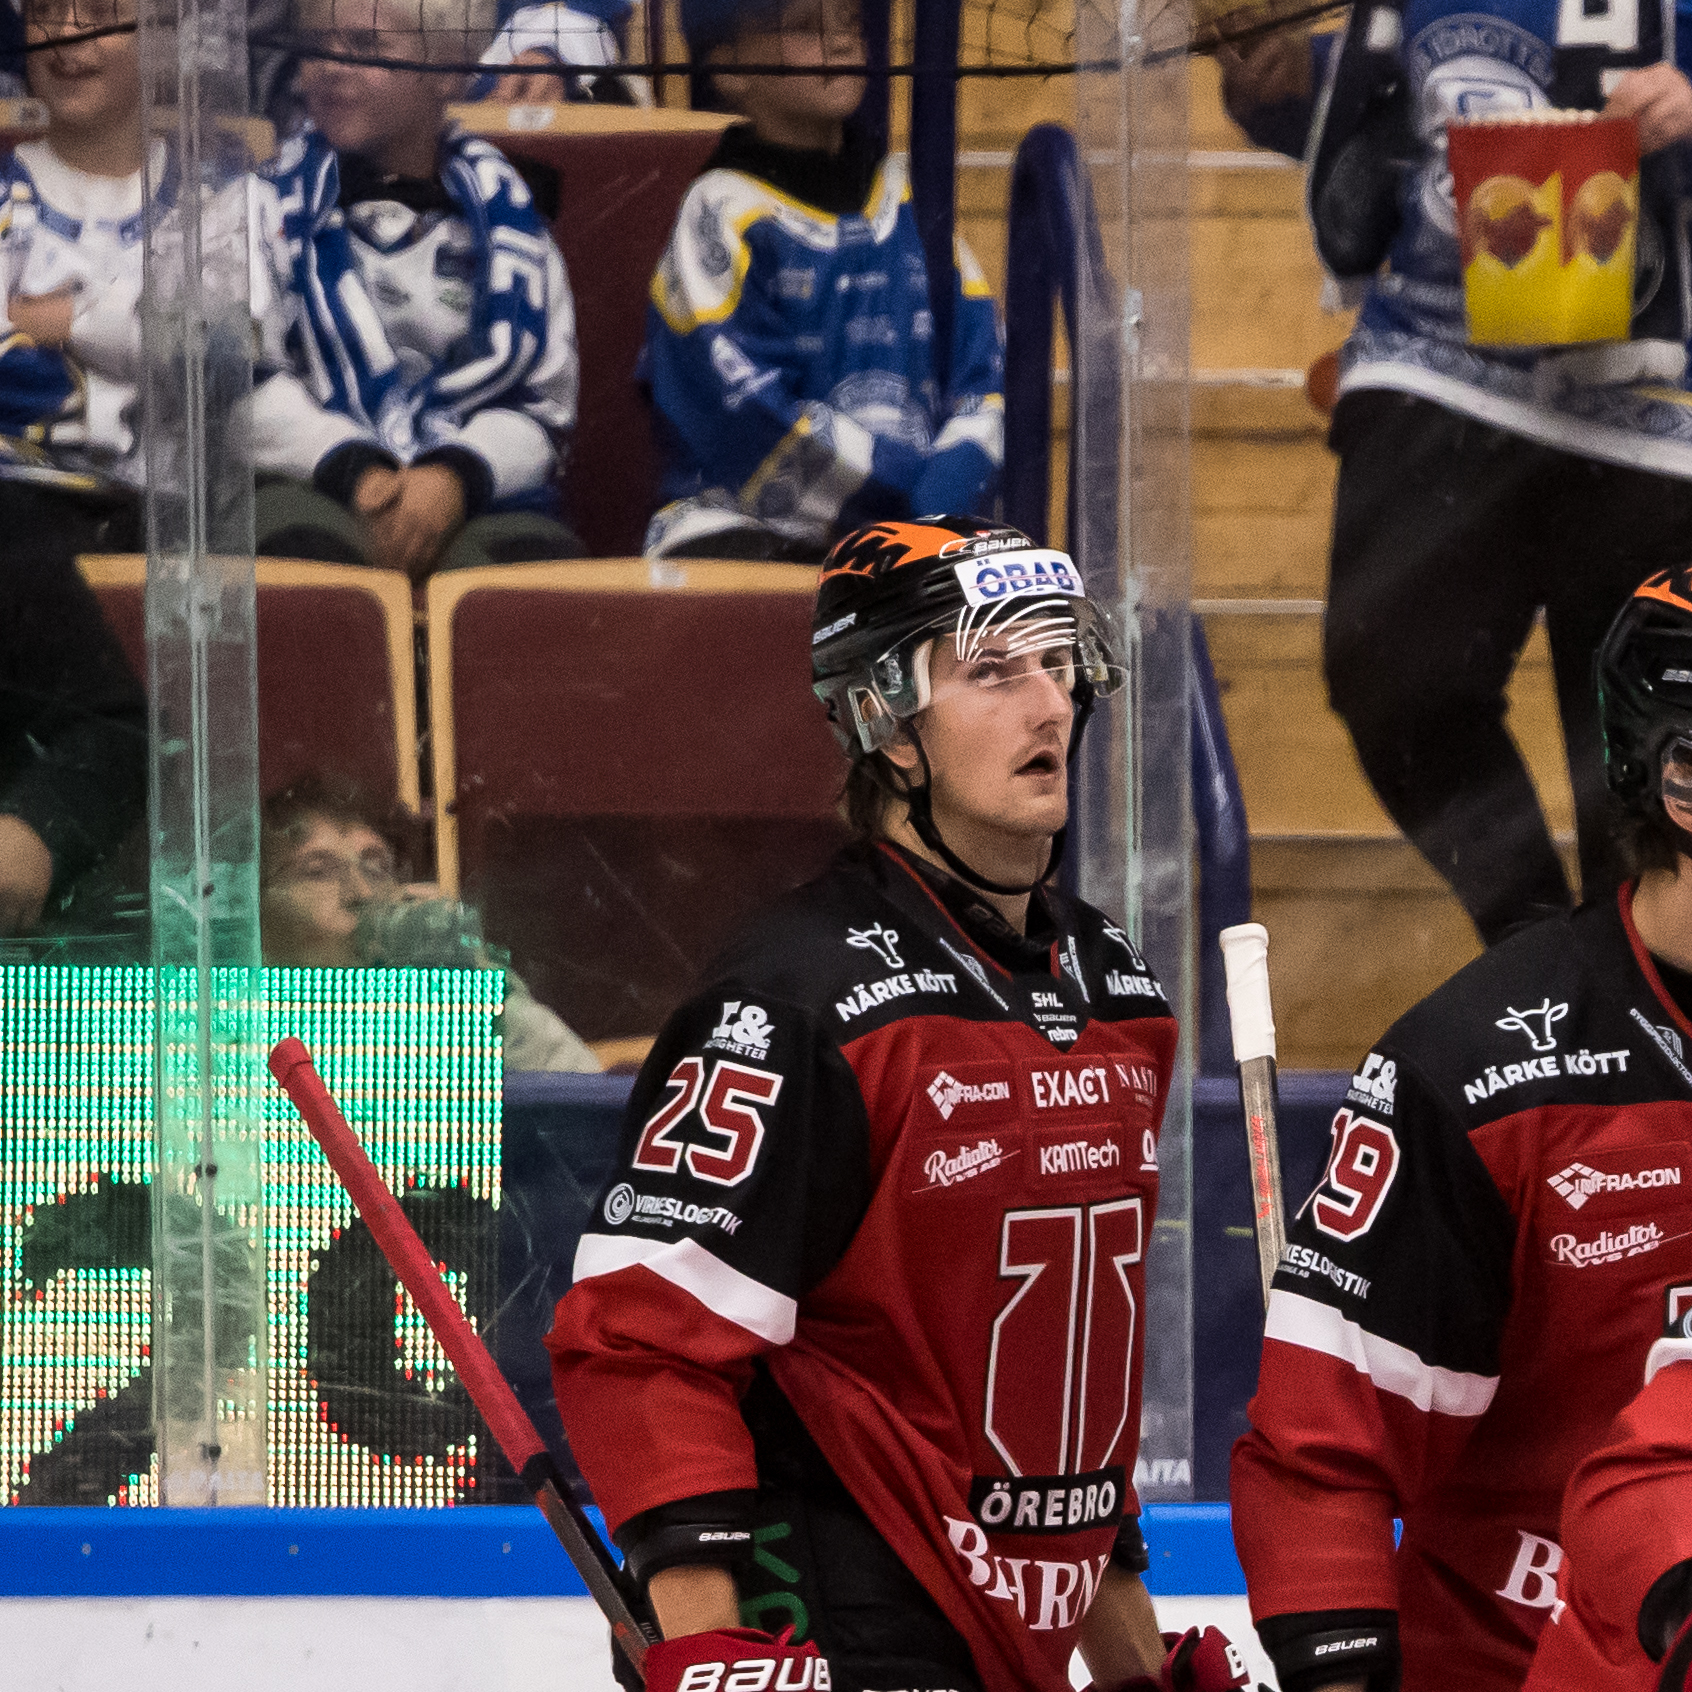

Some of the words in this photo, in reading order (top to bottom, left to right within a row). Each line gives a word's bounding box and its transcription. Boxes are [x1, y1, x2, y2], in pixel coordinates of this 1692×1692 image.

[835, 974, 917, 1022] NÄRKE
[916, 968, 959, 995] KÖTT
[1031, 992, 1064, 1008] SHL
[1031, 1066, 1110, 1109] EXACT
[1463, 1055, 1560, 1104] NÄRKE
[1564, 1048, 1630, 1076] KÖTT
[632, 1056, 784, 1187] 25
[922, 1138, 1003, 1187] Radiator
[1040, 1139, 1121, 1176] KAMTech
[1549, 1221, 1664, 1268] Radiator
[980, 1481, 1117, 1527] ÖREBRO
[1314, 1636, 1379, 1656] BAUER
